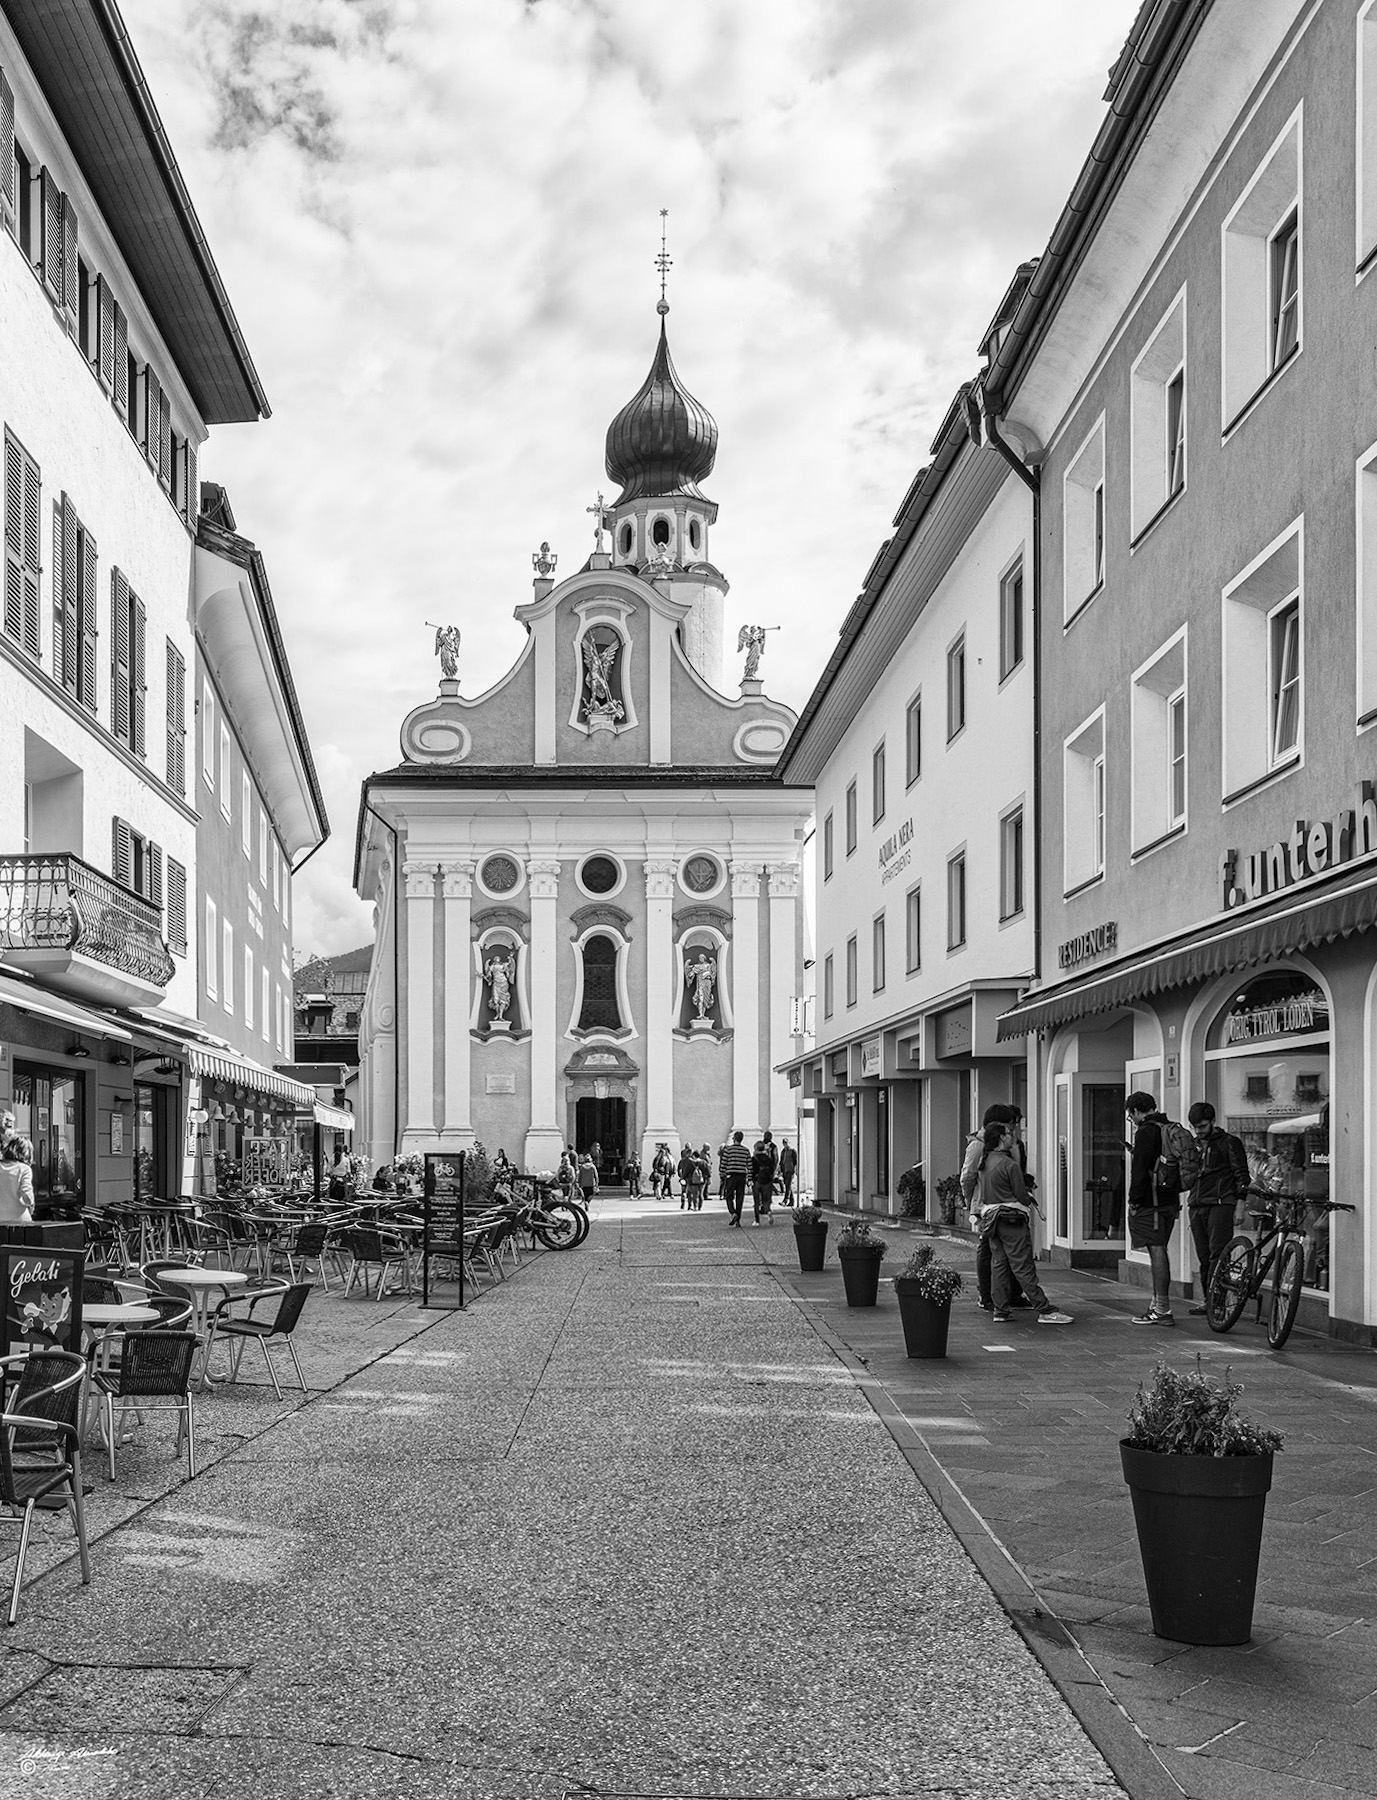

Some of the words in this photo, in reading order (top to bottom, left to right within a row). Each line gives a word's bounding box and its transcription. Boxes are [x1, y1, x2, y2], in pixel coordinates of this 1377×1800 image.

[899, 817, 914, 850] NERA
[1058, 921, 1117, 969] RESIDENCE
[1283, 1002, 1313, 1031] LODEN
[10, 1260, 60, 1298] Gelati
